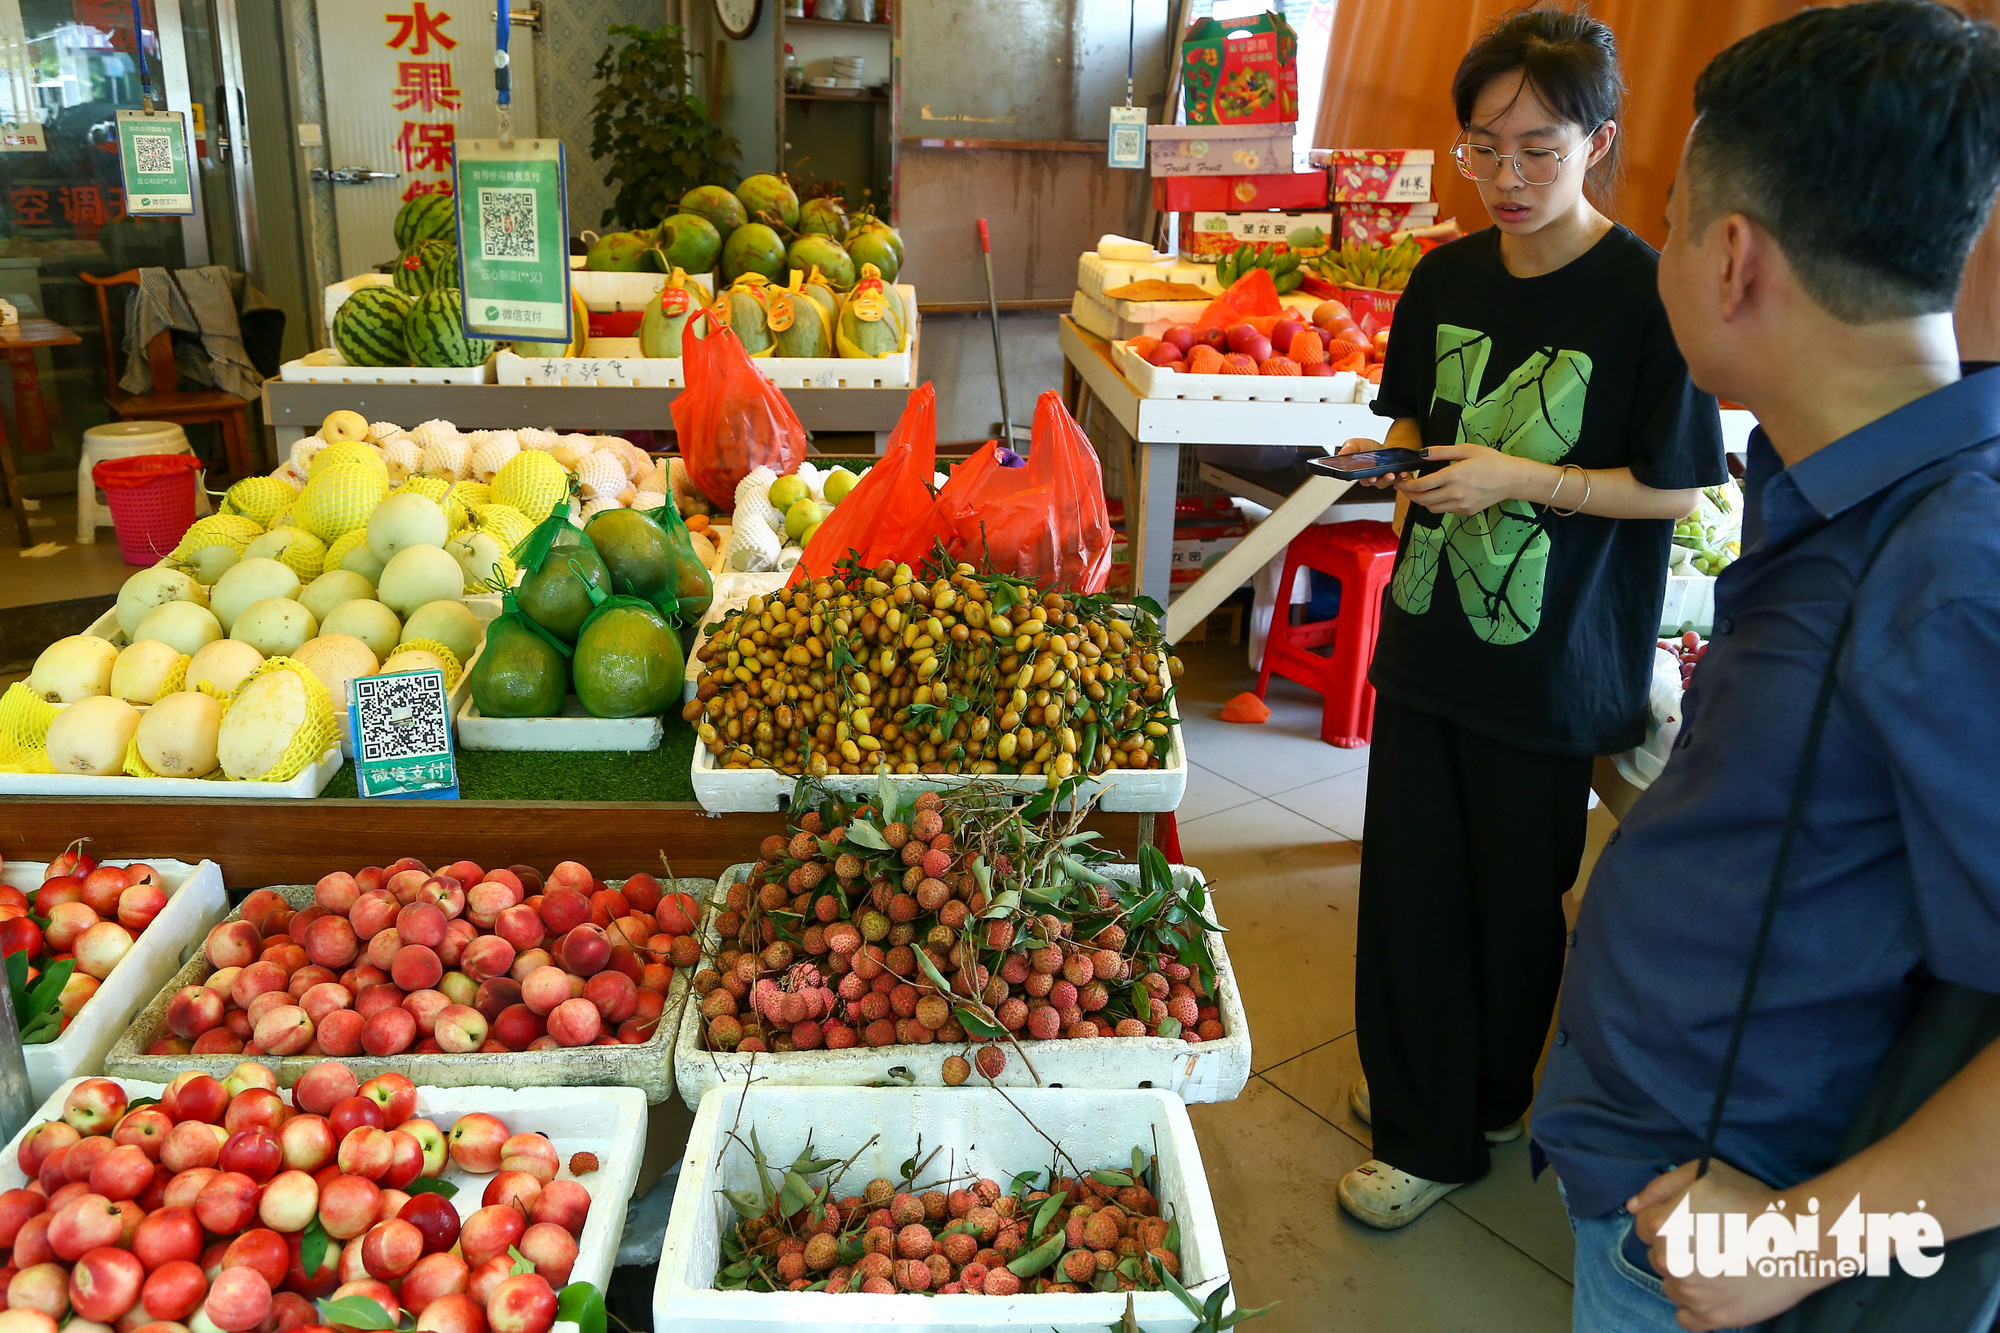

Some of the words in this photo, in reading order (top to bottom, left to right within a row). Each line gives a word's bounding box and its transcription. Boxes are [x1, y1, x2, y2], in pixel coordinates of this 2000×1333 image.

[1164, 163, 1190, 174] Fresh
[1197, 162, 1223, 173] Fruit
[473, 170, 540, 182] 推荐使用微信支付
[152, 198, 178, 206] 微信支付
[502, 308, 542, 323] 微信支付
[372, 762, 445, 783] 微信支付
